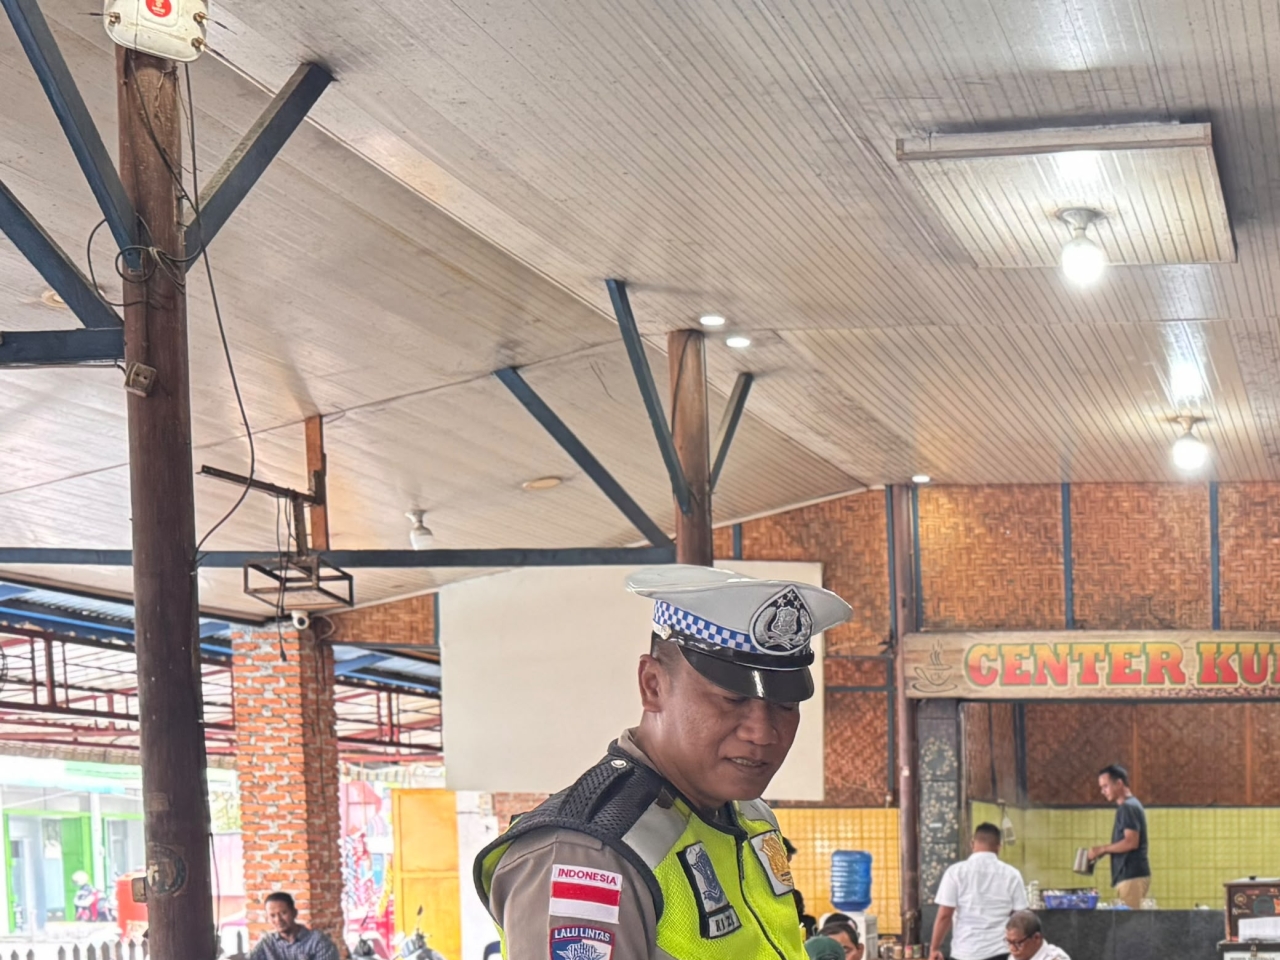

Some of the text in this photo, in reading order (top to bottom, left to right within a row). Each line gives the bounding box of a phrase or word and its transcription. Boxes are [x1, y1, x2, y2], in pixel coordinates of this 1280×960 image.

[965, 642, 1187, 687] CENTER
[557, 867, 618, 886] INDONESIA
[554, 928, 611, 942] LALU LINTAS
